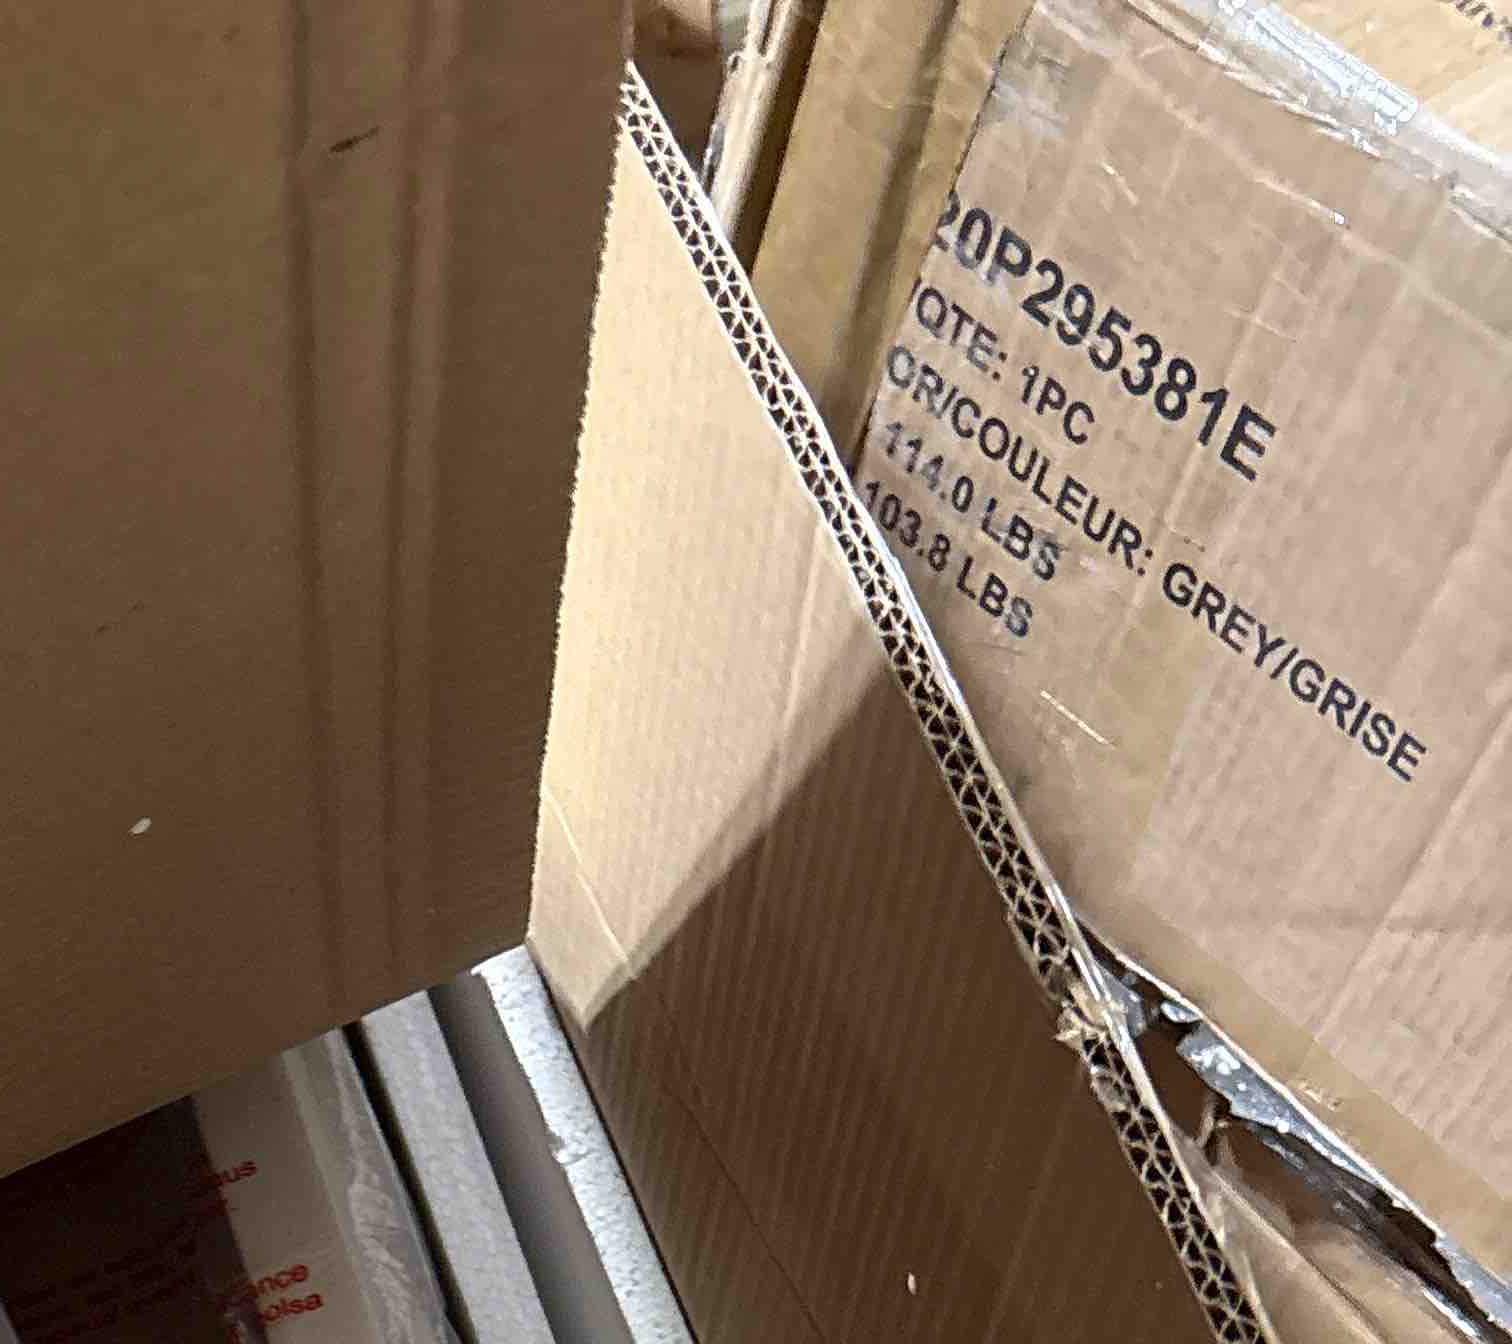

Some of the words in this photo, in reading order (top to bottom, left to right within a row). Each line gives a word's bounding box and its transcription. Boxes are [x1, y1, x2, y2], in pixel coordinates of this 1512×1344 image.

[1021, 365, 1095, 445] 1PC
[866, 480, 951, 571] 103.8
[956, 556, 1033, 638] LBS
[886, 421, 974, 513] 114.0
[981, 497, 1061, 581] LBS
[1161, 562, 1427, 783] GREY/GRISE
